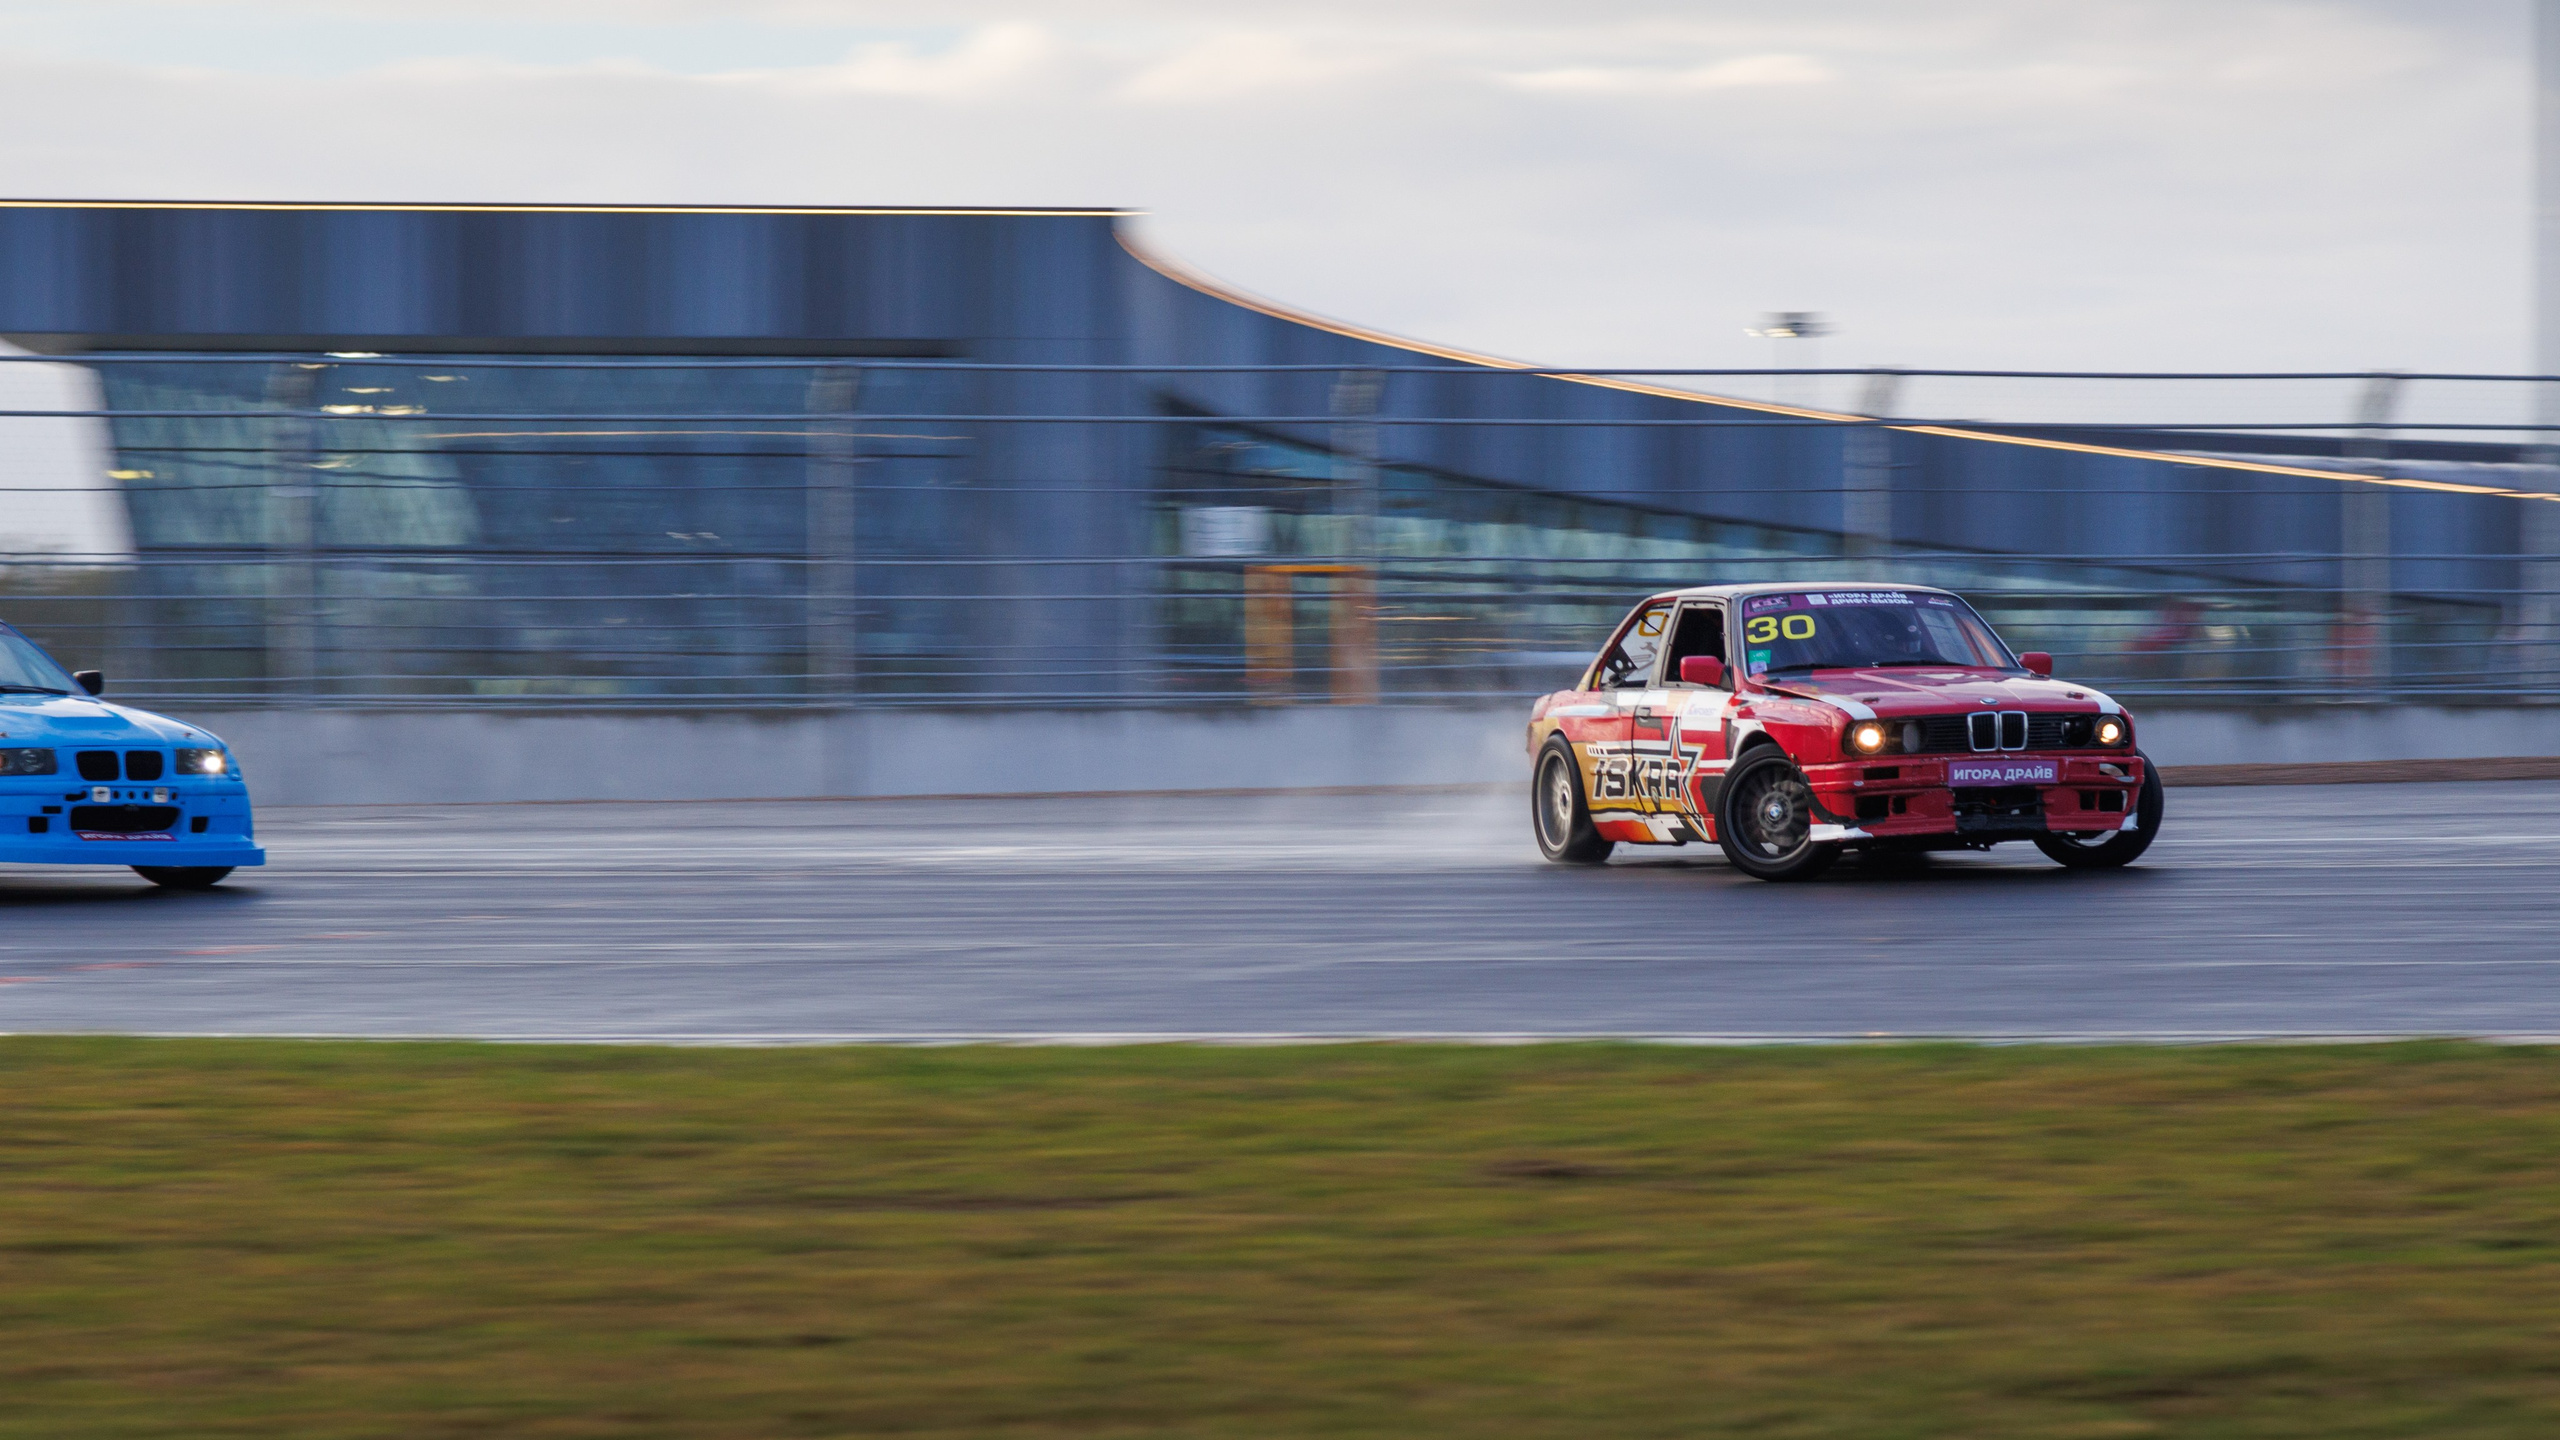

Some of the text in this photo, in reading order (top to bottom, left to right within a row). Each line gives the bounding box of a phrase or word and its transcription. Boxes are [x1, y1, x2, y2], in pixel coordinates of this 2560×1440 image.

[1747, 614, 1816, 644] 30
[1592, 758, 1683, 800] ISKRA
[1953, 765, 2053, 781] ИГОРА ДРАЙВ
